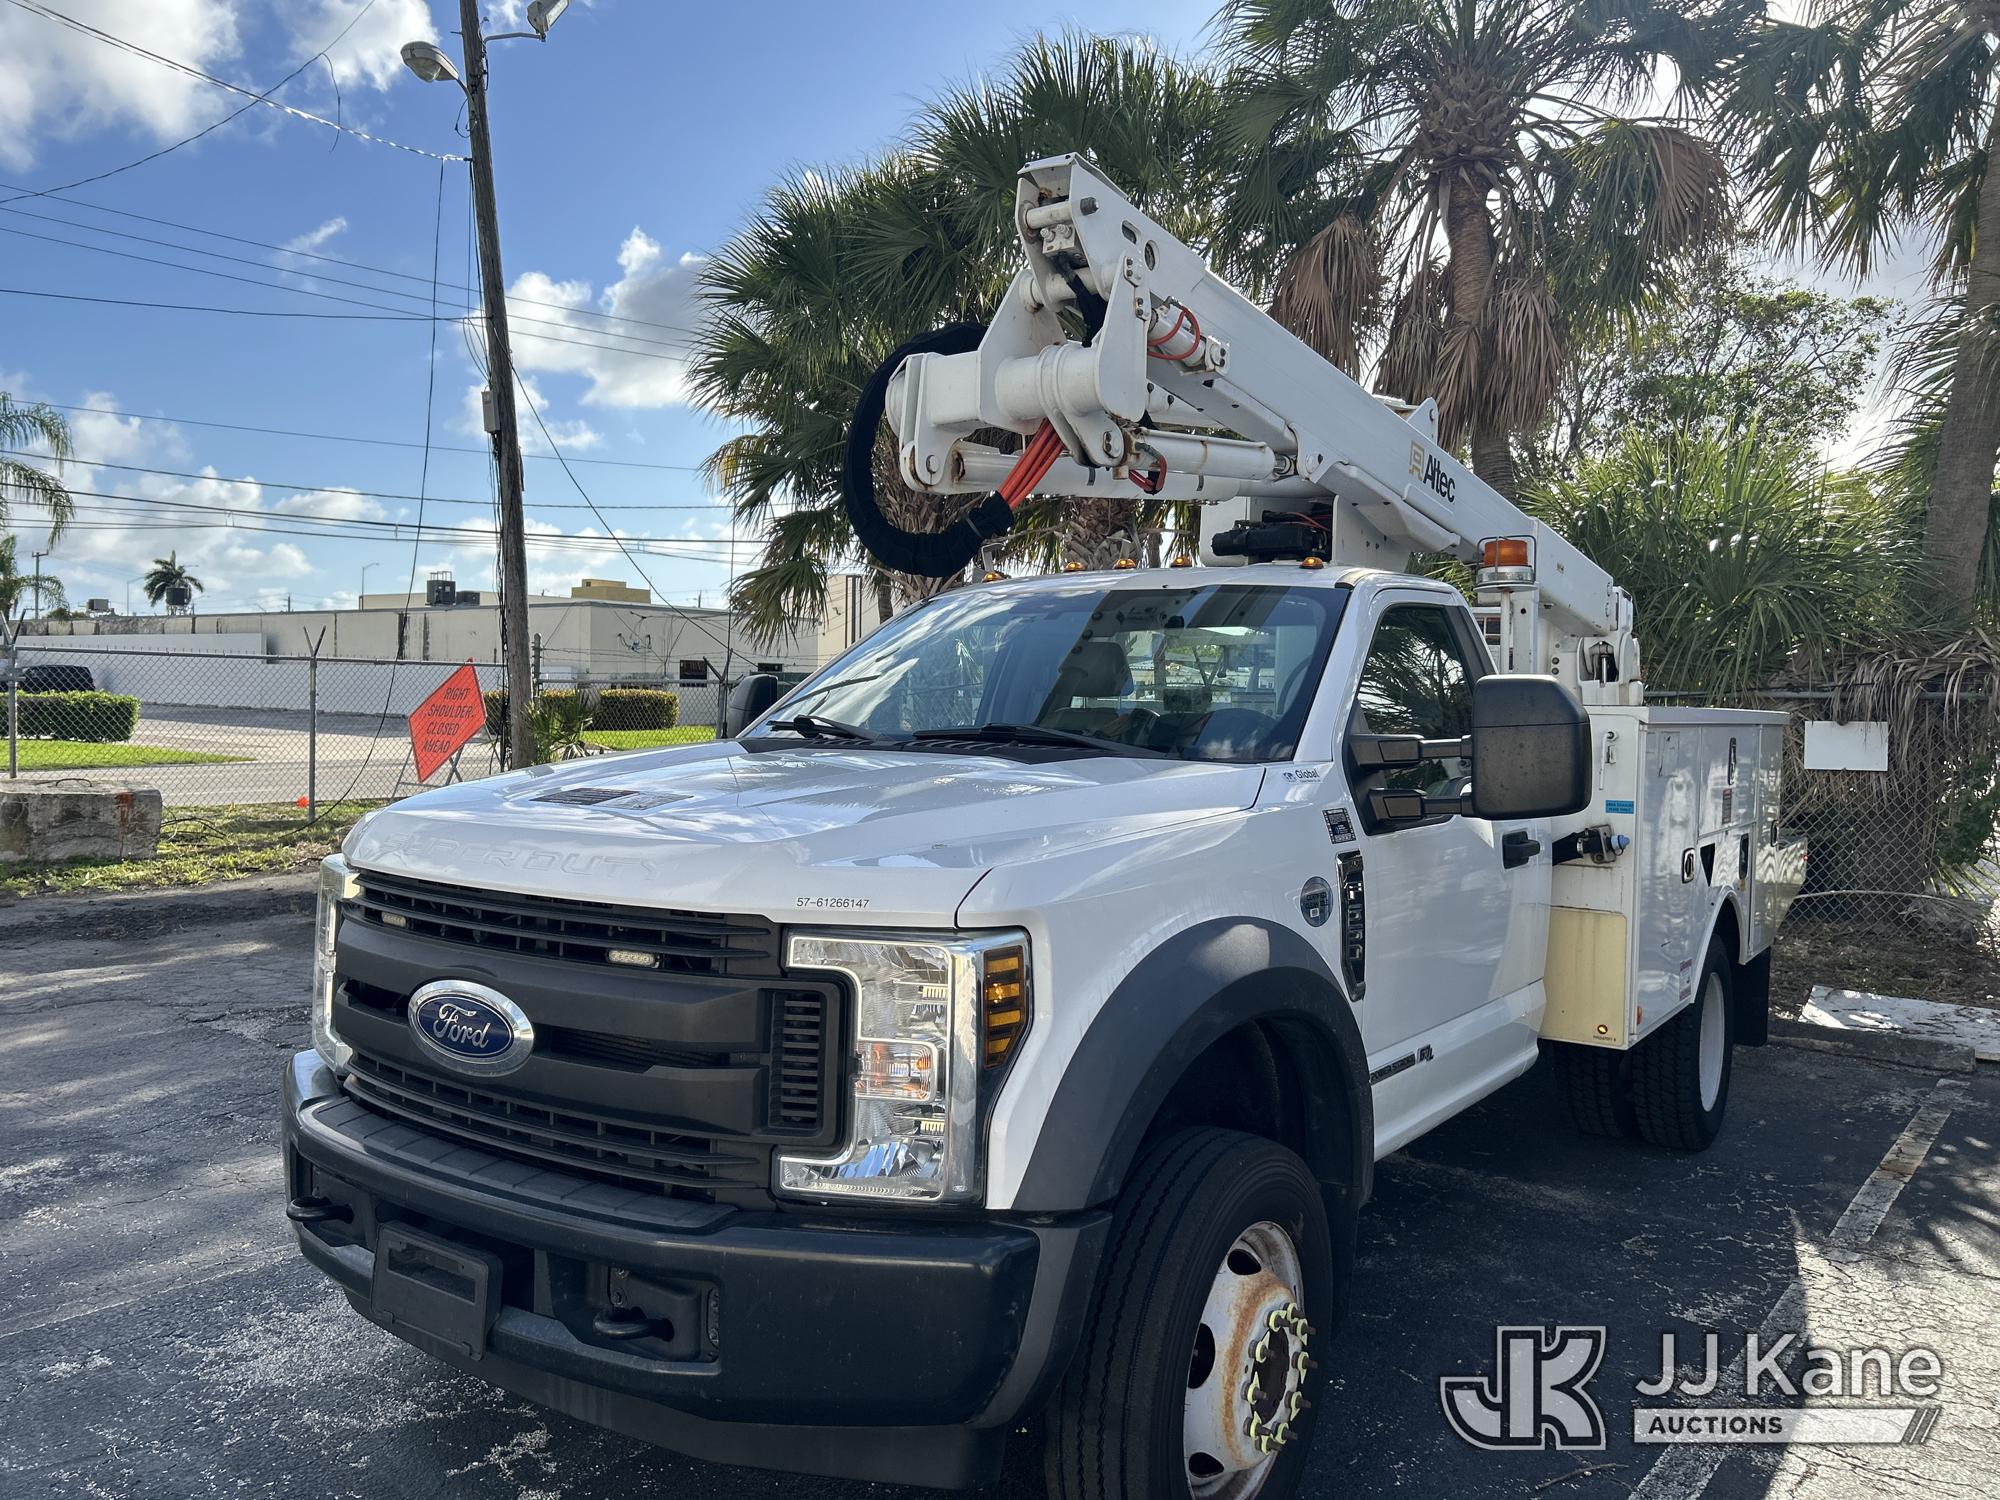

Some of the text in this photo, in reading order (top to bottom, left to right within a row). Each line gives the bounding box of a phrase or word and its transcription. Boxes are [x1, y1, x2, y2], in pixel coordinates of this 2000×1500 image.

[1423, 454, 1456, 502] Altec
[444, 688, 471, 700] RIGHT
[428, 704, 473, 718] SHOULDER
[426, 722, 460, 735] CLOSED
[422, 739, 450, 752] AHEAD
[1295, 769, 1320, 778] Global
[797, 897, 870, 908] 57-61266147
[433, 1003, 492, 1048] Ford
